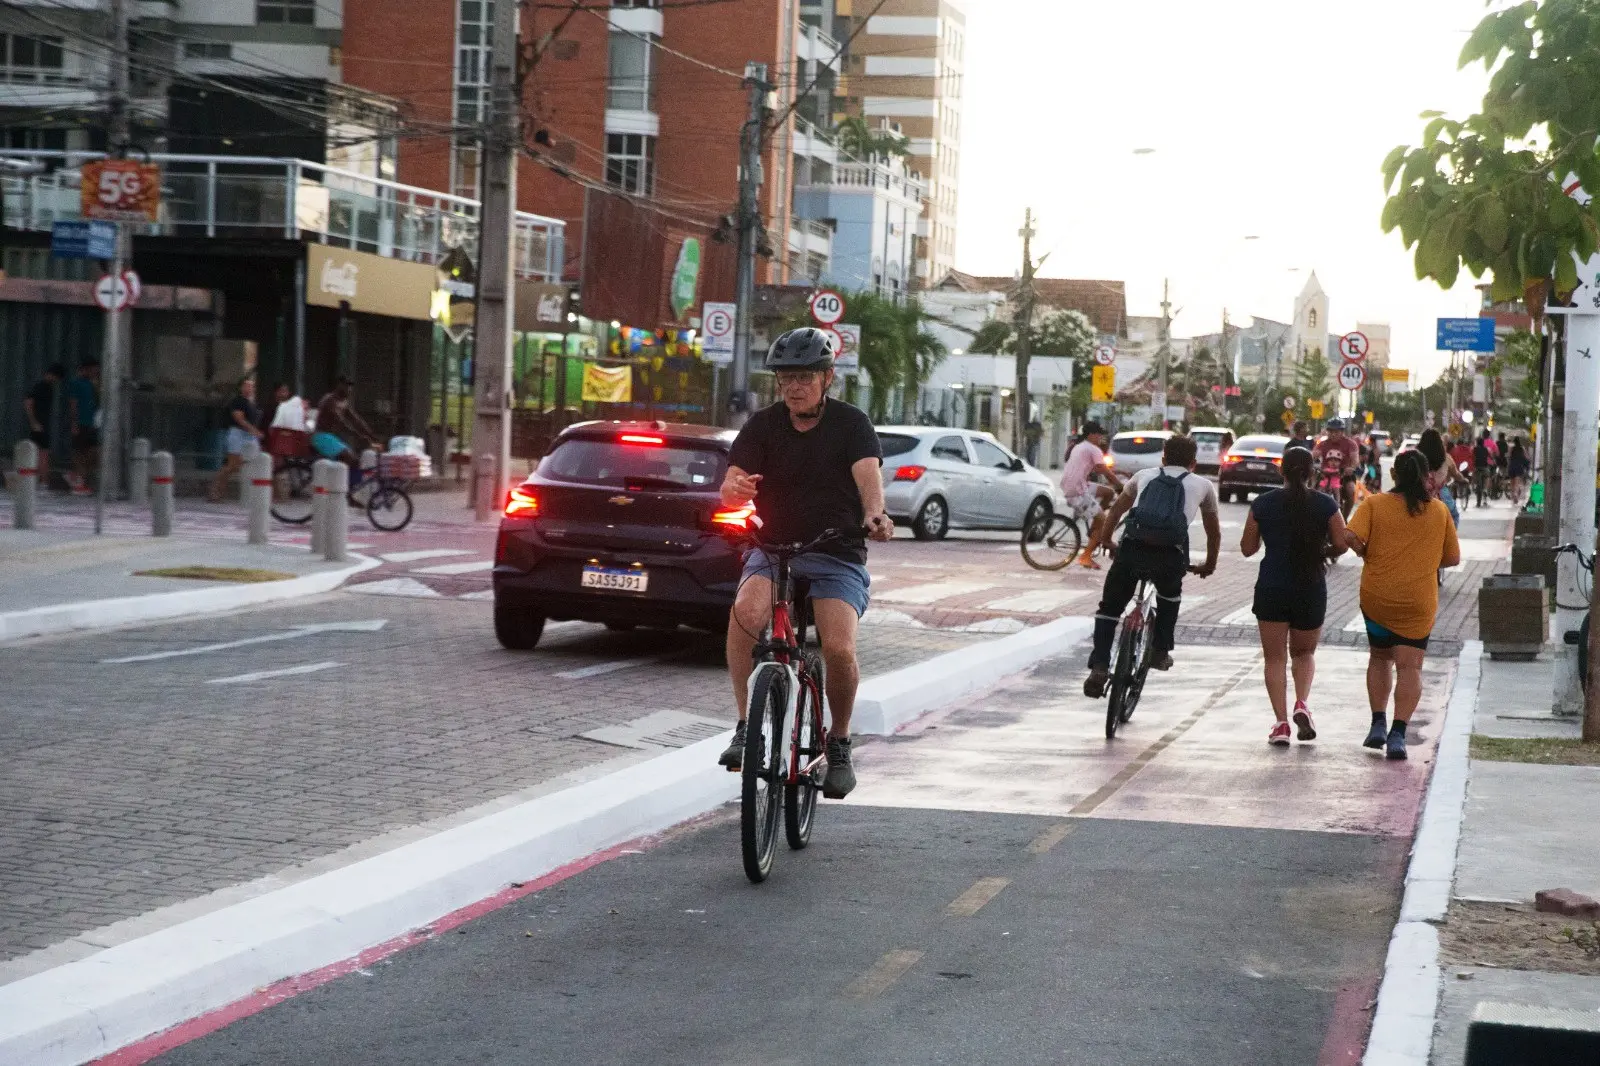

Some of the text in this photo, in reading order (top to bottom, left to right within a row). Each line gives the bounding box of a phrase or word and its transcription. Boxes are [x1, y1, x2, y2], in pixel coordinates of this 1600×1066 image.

[98, 171, 140, 203] 5G
[816, 298, 839, 312] 40
[714, 316, 723, 330] E
[1349, 338, 1359, 354] E
[1343, 367, 1360, 379] 40
[588, 574, 640, 589] SAS5J91
